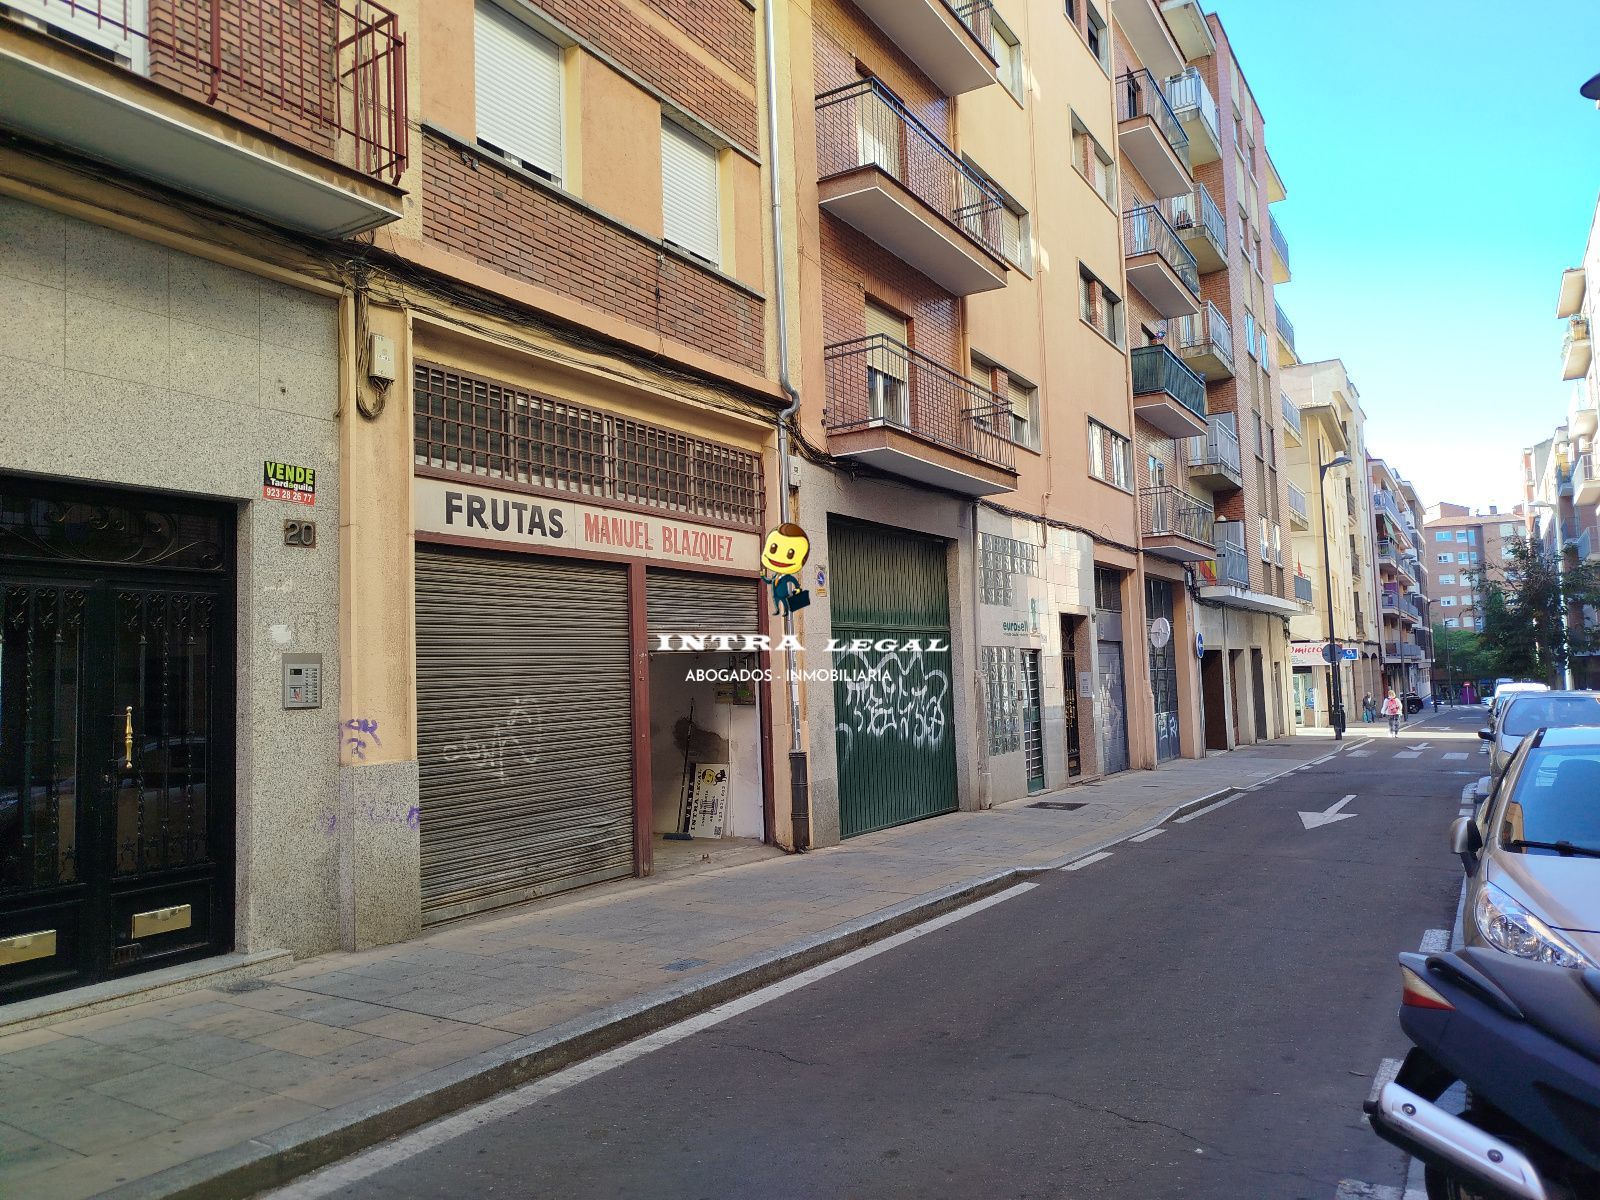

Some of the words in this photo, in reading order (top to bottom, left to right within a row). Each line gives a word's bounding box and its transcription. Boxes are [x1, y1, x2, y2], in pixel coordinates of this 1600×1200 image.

[266, 462, 314, 485] VENDE
[266, 487, 280, 498] 923
[282, 490, 291, 500] 28
[293, 492, 302, 501] 26
[304, 494, 312, 503] 77
[286, 521, 314, 545] 20
[445, 491, 564, 539] FRUTAS
[584, 512, 653, 551] MANUEL
[662, 525, 734, 561] BLAZQUEZ
